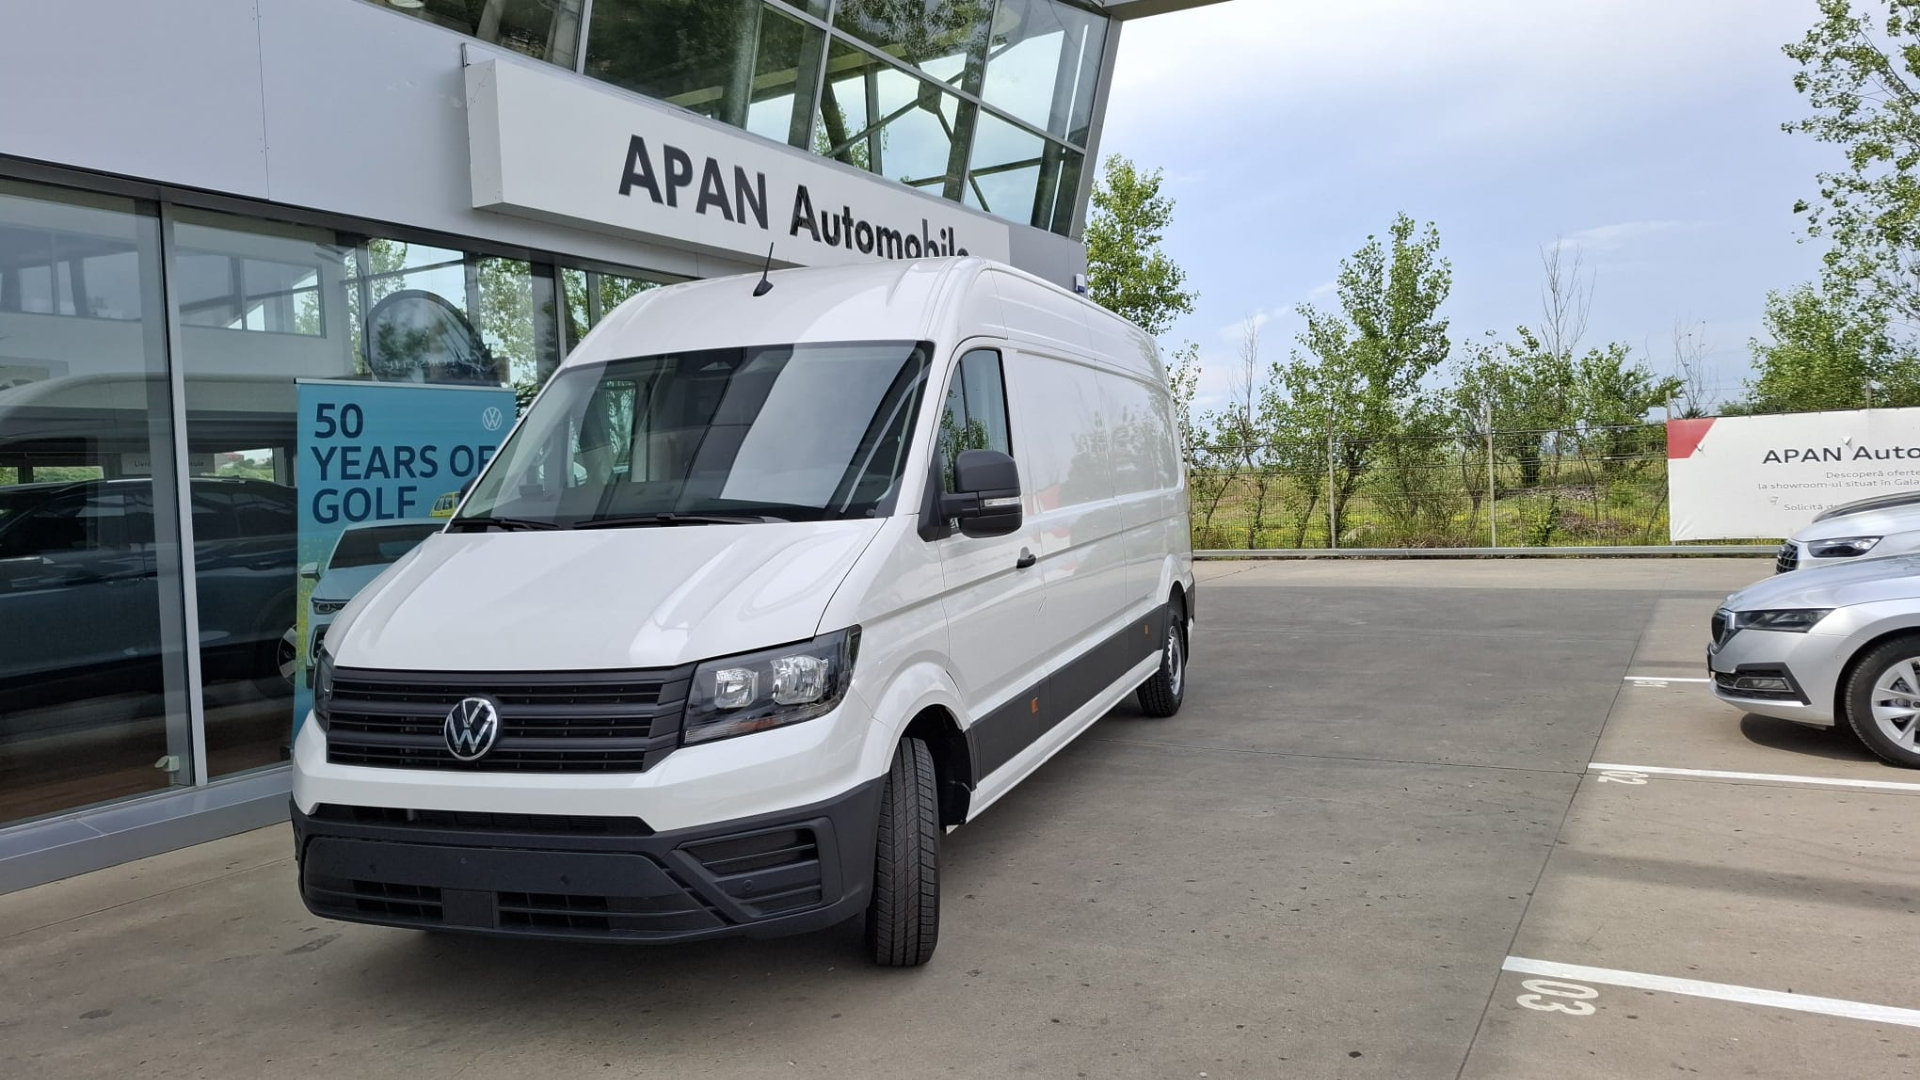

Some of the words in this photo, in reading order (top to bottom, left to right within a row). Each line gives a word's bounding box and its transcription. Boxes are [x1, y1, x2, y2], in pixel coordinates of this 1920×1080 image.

[618, 134, 769, 230] APAN
[789, 184, 969, 259] Automobil
[314, 403, 364, 438] 50
[310, 445, 438, 481] YEARS
[450, 445, 497, 477] OF
[1762, 447, 1842, 464] APAN
[1852, 446, 1920, 461] Auto
[1770, 481, 1842, 489] showroom-ul
[1845, 480, 1877, 488] situat
[312, 486, 417, 524] GOLF
[444, 697, 497, 760] VW
[1597, 770, 1649, 784] 02
[1516, 979, 1599, 1016] 03
